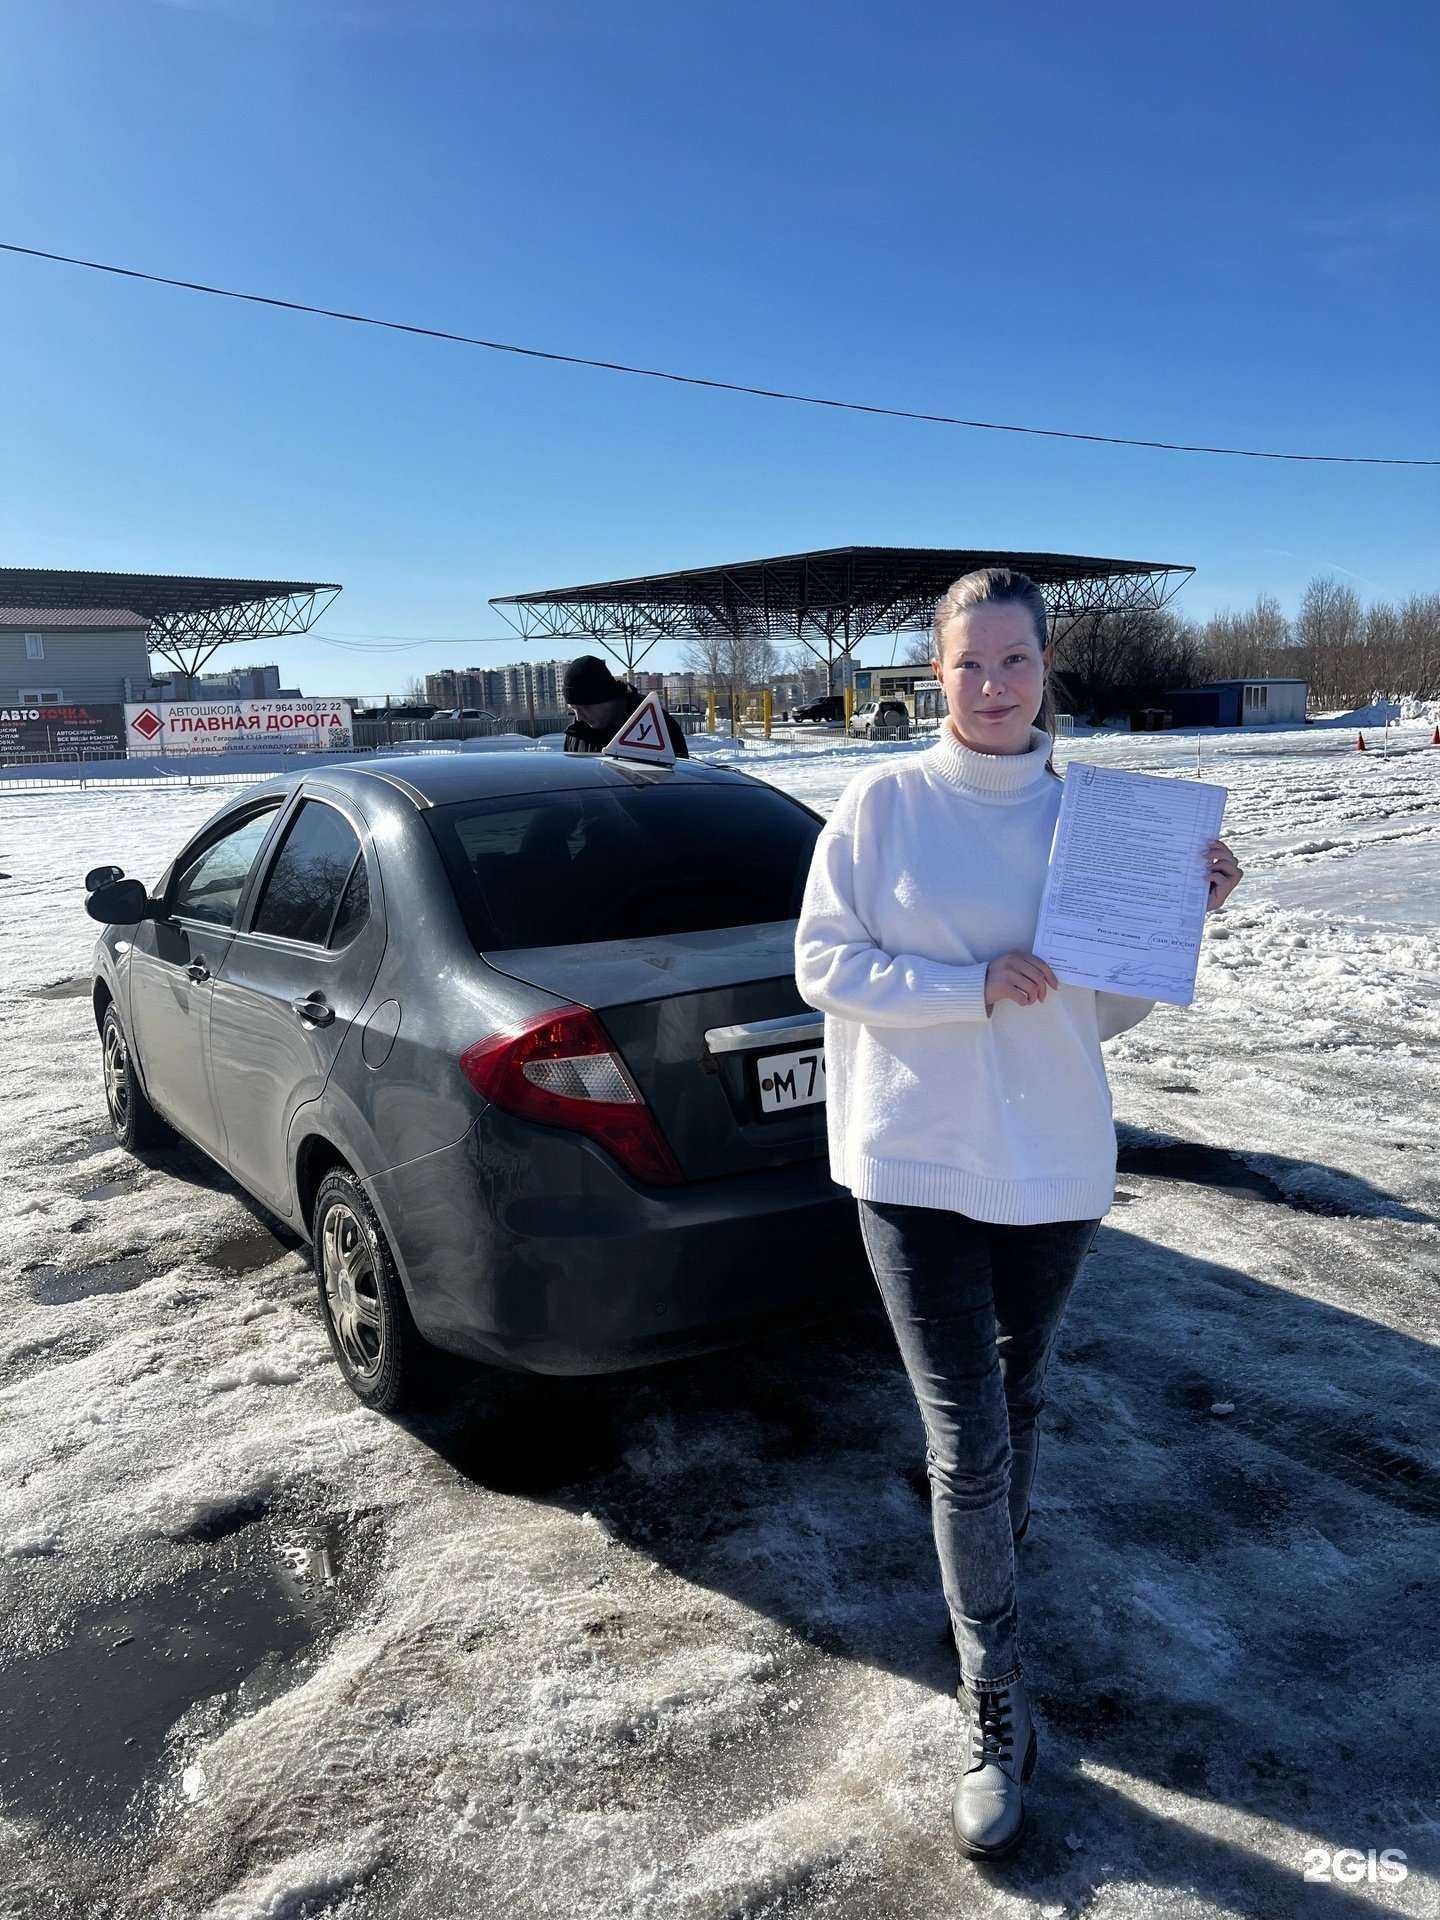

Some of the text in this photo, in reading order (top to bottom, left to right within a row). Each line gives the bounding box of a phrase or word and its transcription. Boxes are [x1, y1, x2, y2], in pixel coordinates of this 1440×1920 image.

[168, 705, 242, 717] АВТОШКОЛА
[260, 702, 341, 713] +7 964 300 22 22
[170, 713, 342, 732] ГЛАВНАЯ ДОРОГА
[637, 723, 653, 741] У
